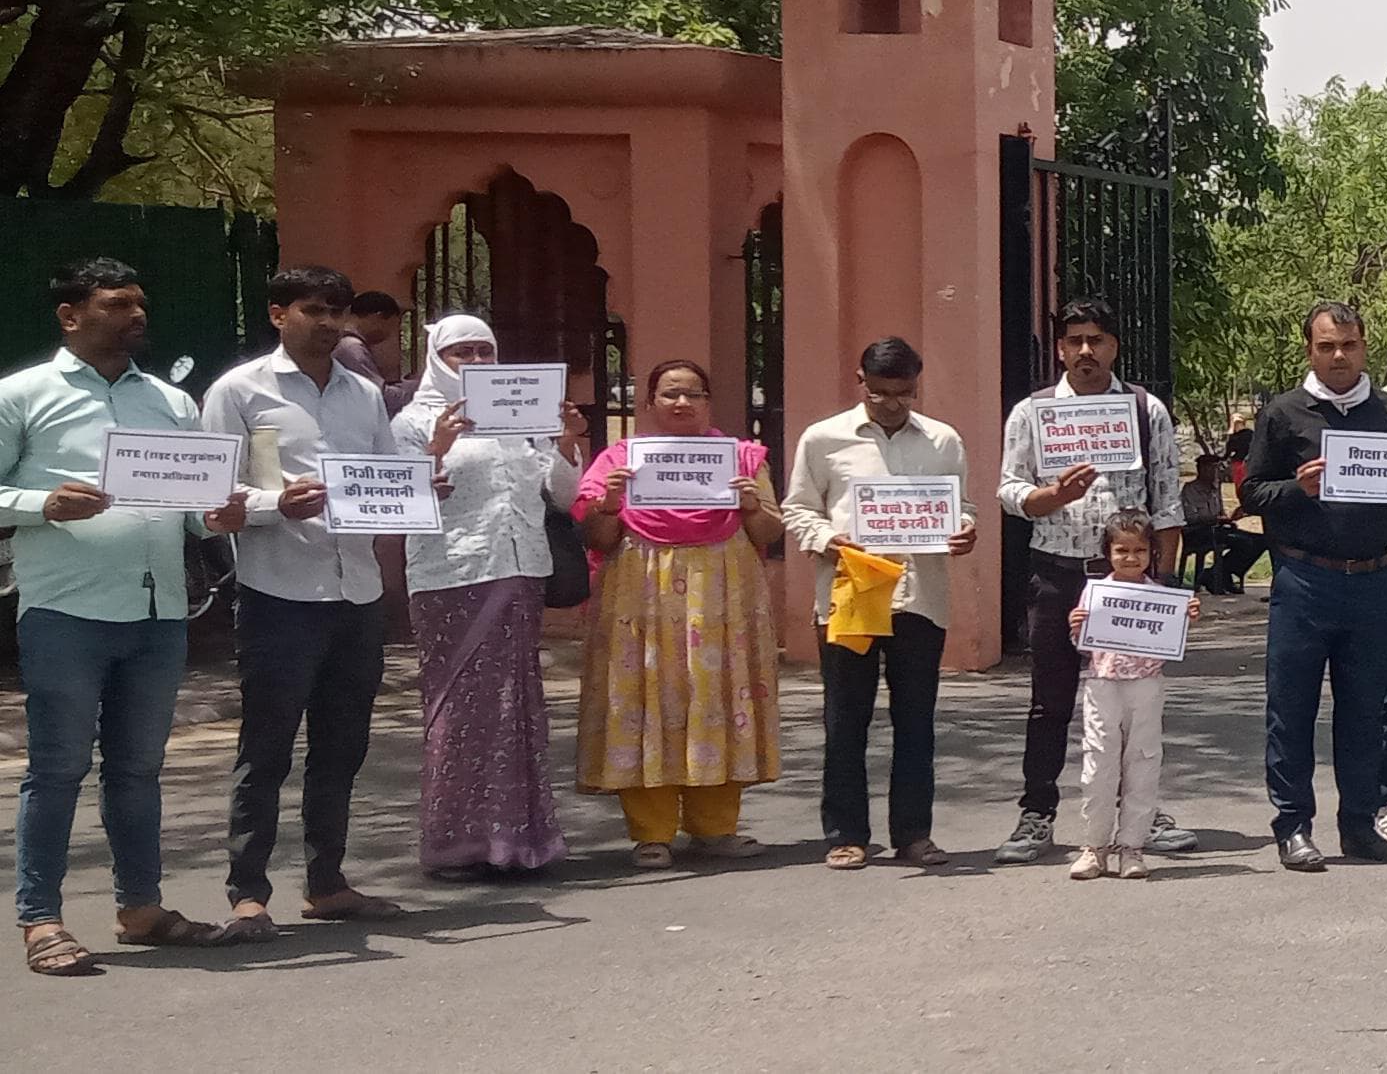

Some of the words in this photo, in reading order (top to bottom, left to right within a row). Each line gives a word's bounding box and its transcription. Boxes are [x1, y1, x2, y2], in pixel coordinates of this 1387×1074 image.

[1046, 424, 1076, 437] निजी
[1112, 421, 1128, 434] की
[1044, 439, 1089, 454] मनमानी
[1110, 437, 1131, 449] करो
[116, 448, 140, 458] RTE
[644, 453, 685, 464] सरकार
[688, 454, 723, 464] हमारा
[1348, 447, 1380, 460] शिक्षा
[342, 466, 374, 479] निजी
[377, 466, 414, 483] स्कूलों
[656, 471, 680, 481] क्या
[682, 471, 713, 485] कसूर
[1339, 464, 1387, 478] अधिकार
[344, 484, 361, 497] की
[364, 485, 414, 498] मनमानी
[358, 501, 377, 514] बंद
[380, 502, 404, 515] करो
[1102, 596, 1141, 611] सरकार
[1143, 602, 1178, 615] हमारा
[1111, 615, 1132, 628] क्या
[1136, 618, 1164, 635] कसूर
